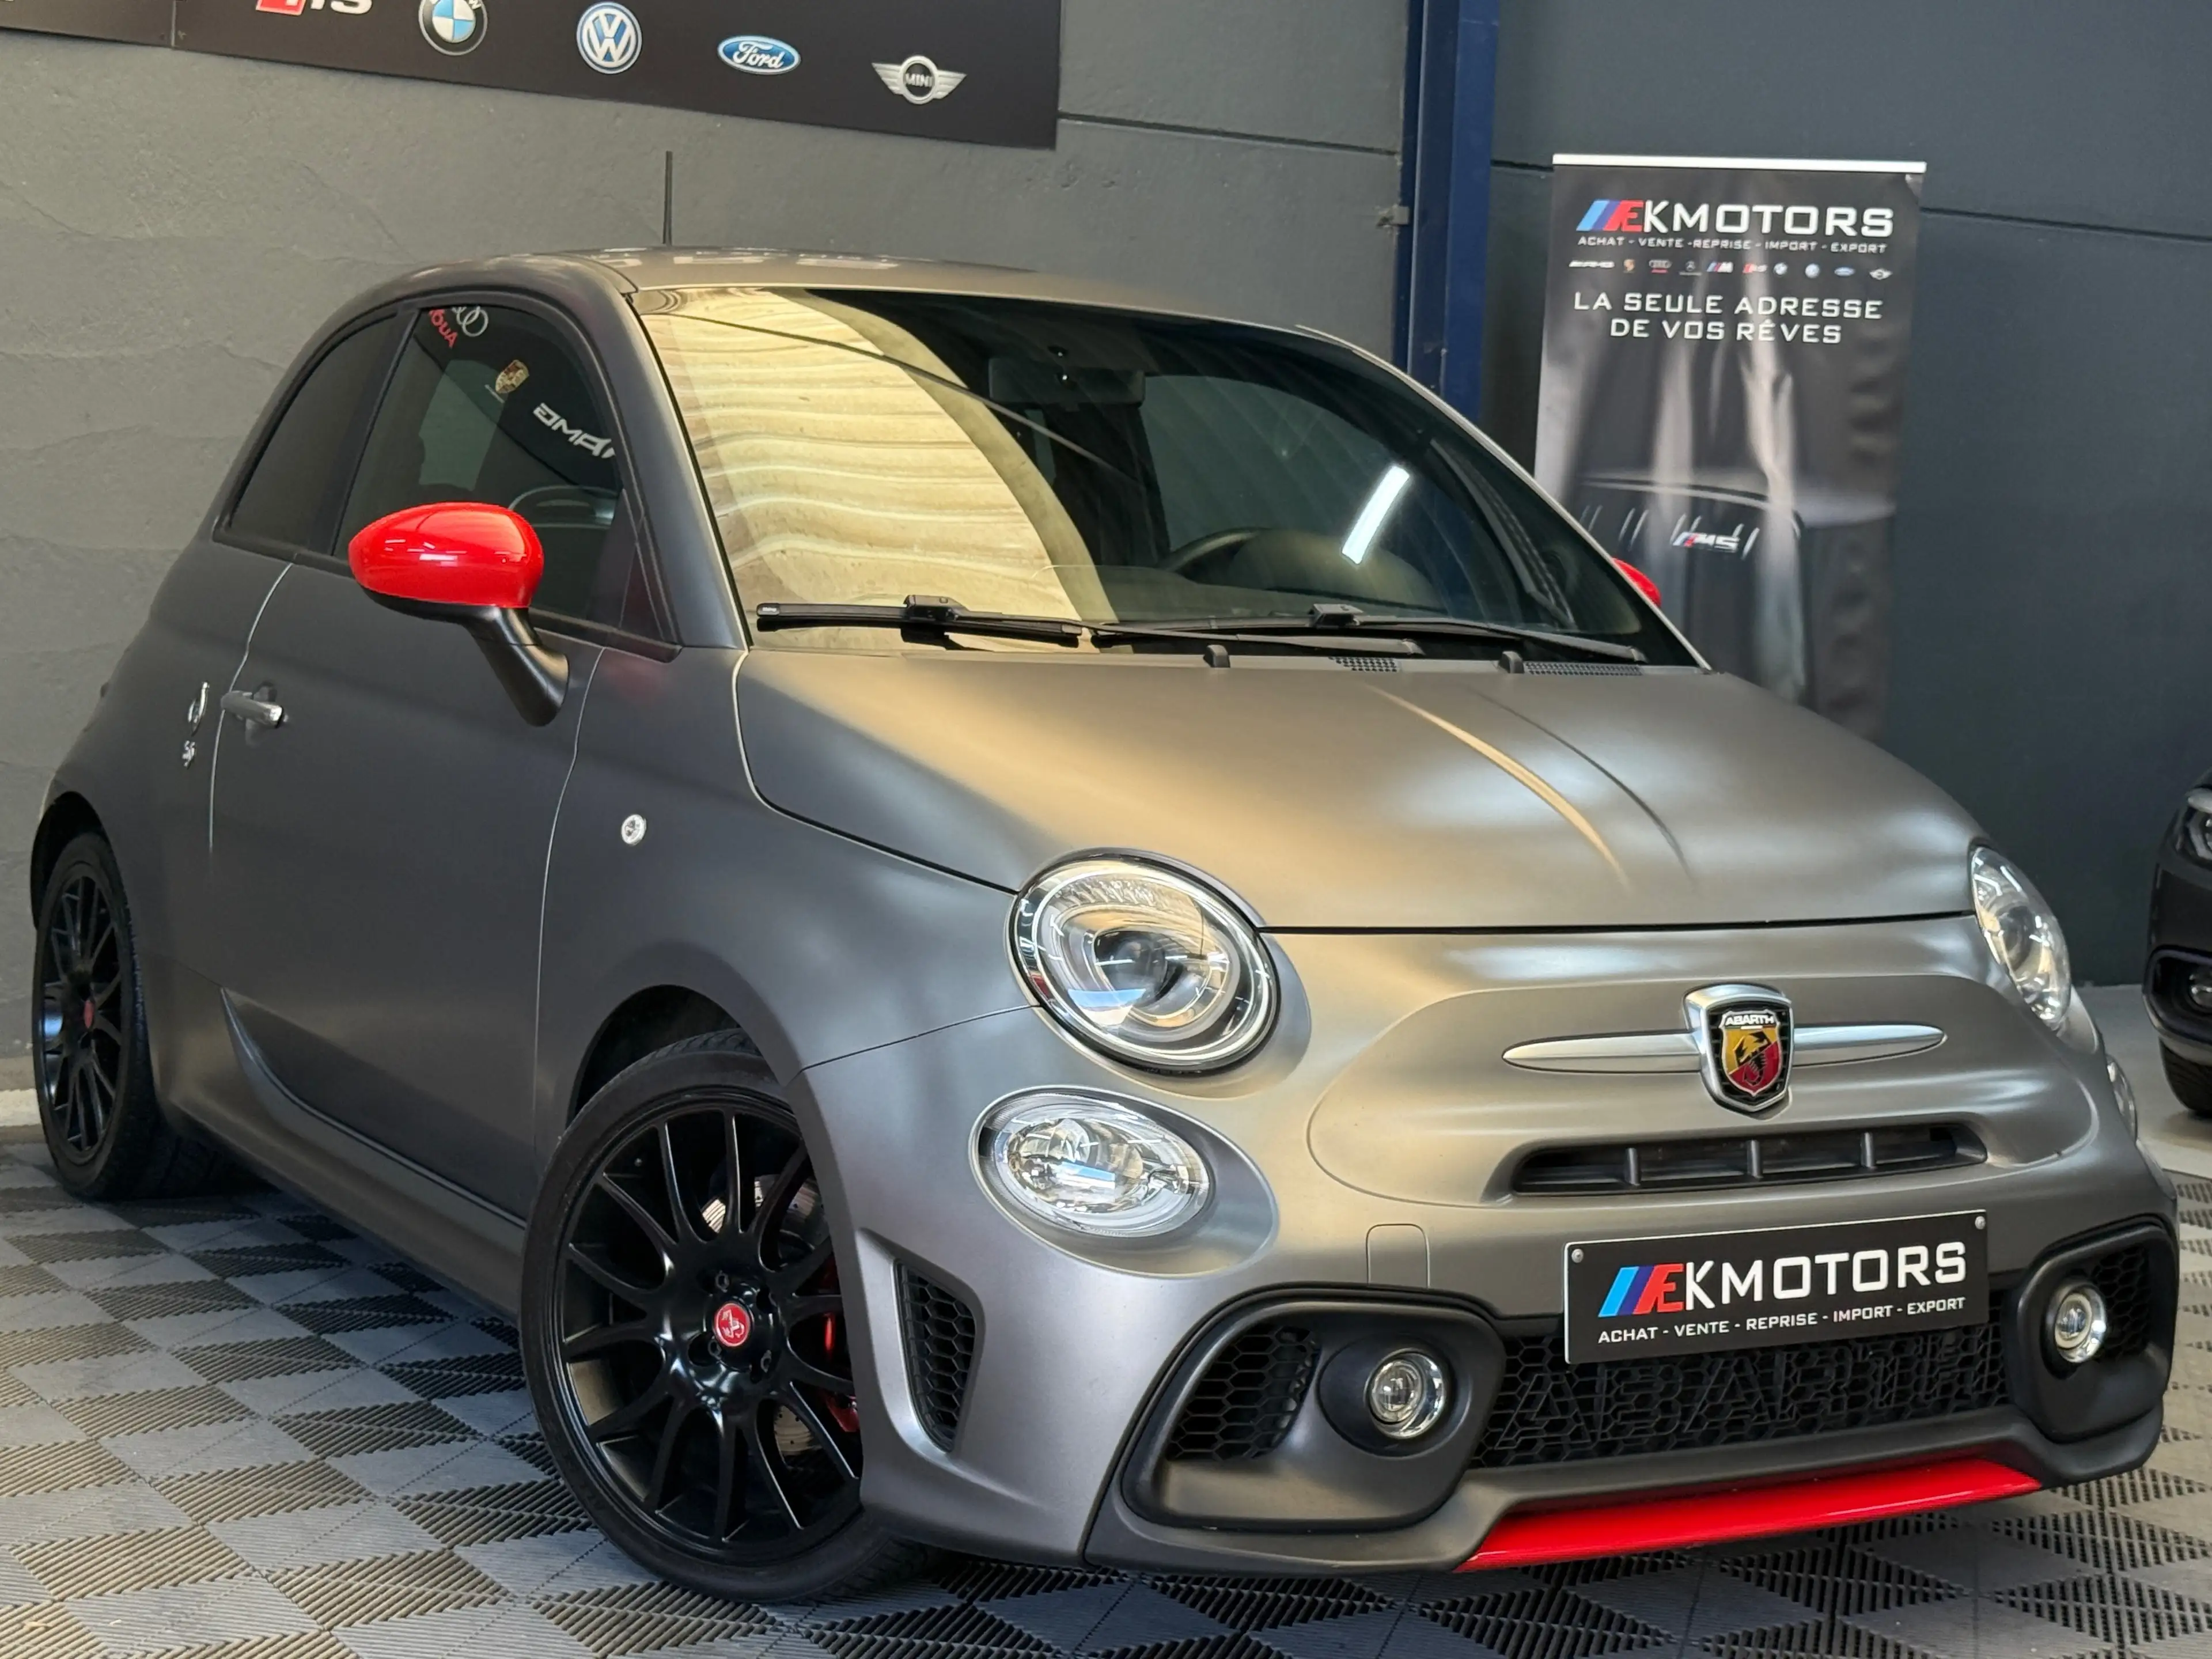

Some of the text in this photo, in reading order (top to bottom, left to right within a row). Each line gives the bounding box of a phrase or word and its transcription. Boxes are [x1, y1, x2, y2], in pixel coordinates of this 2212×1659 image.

[732, 41, 786, 69] Ford
[905, 73, 935, 88] MINI
[1578, 236, 1625, 246] ACHAT
[1638, 238, 1684, 248] VENTE
[1765, 241, 1817, 251] IMPORT
[1831, 242, 1887, 253] EXPORT
[1574, 291, 1883, 319] LA SEULE ADRESSE
[1611, 318, 1842, 344] DE VOS RÊVES
[1725, 1014, 1774, 1025] ABARTH
[1598, 1327, 1658, 1344] ACHAT
[1674, 1320, 1730, 1338] VENTE
[1746, 1312, 1818, 1331] REPRISE
[1833, 1305, 1893, 1323] IMPORT
[1907, 1297, 1966, 1315] EXPORT
